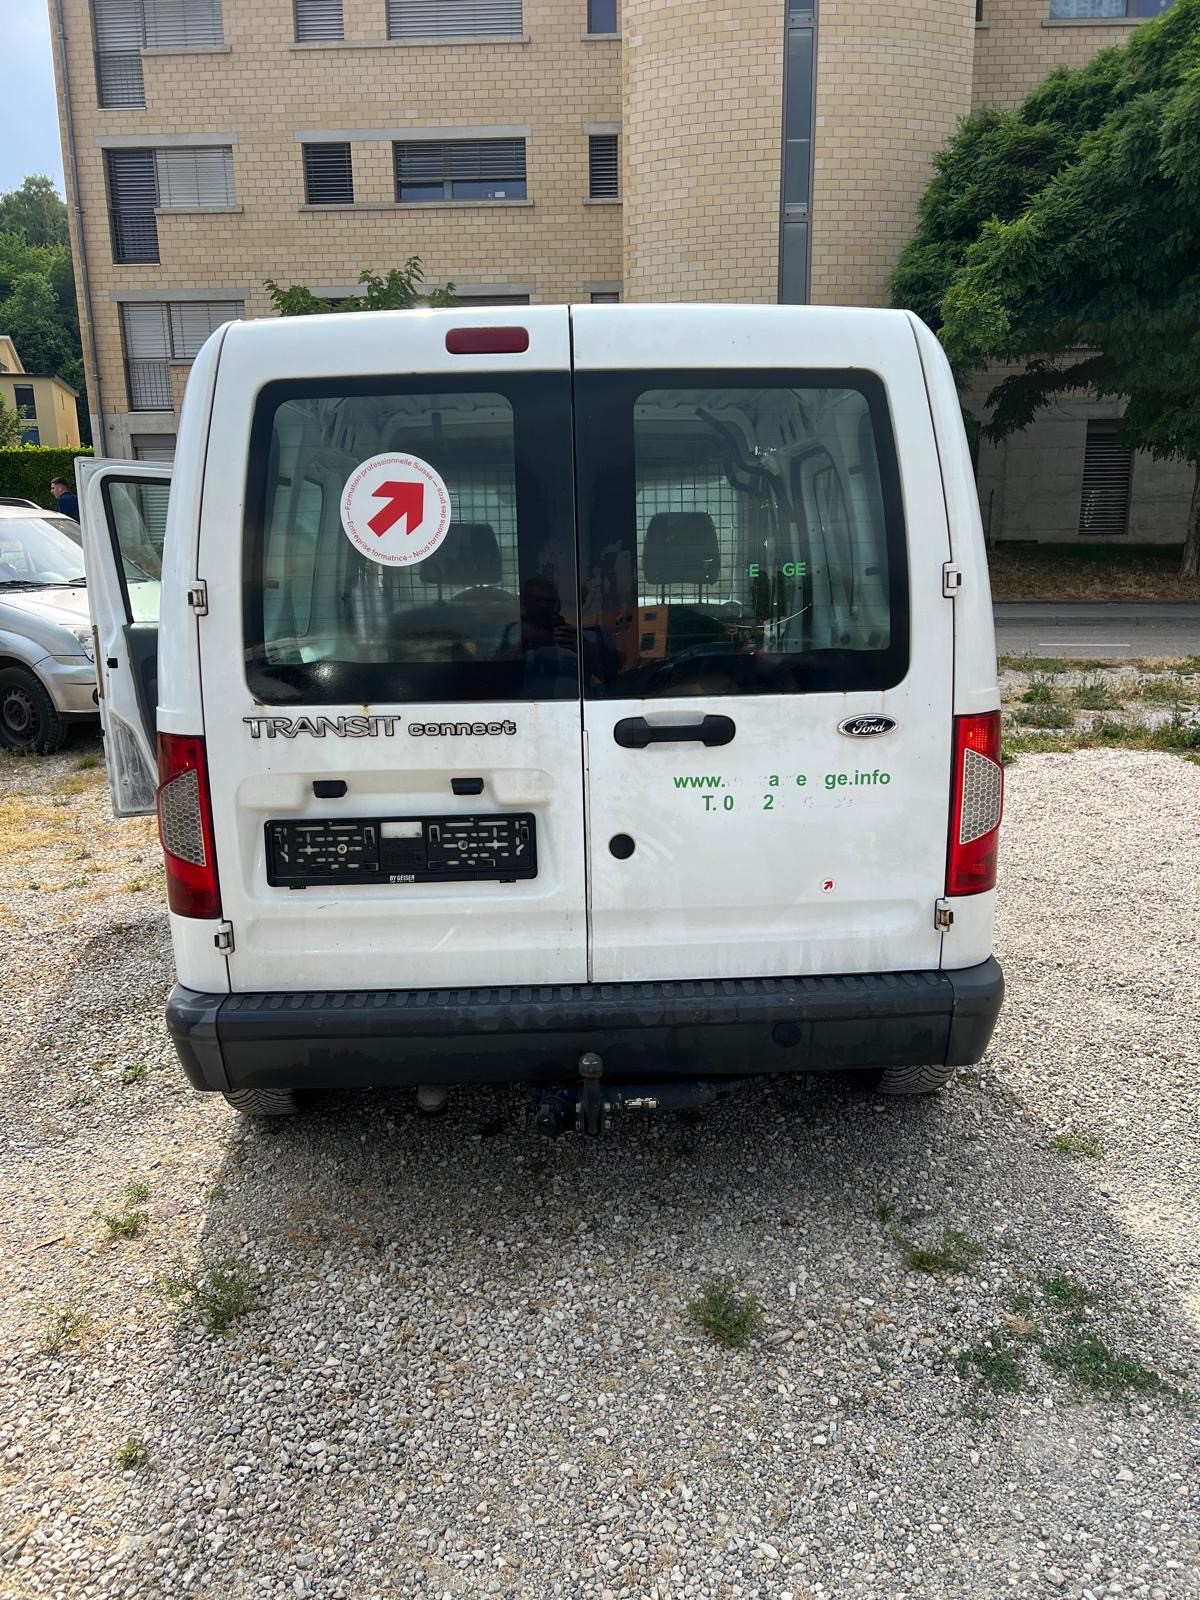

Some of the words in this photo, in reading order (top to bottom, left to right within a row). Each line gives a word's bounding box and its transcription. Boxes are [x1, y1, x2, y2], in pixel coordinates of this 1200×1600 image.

[345, 475, 362, 511] Formation
[361, 458, 412, 477] professionnelle
[413, 462, 433, 480] Suisse
[347, 521, 372, 552] Entreprise
[371, 549, 407, 561] formatrice
[413, 544, 430, 558] Nous
[428, 519, 446, 546] formons
[437, 487, 447, 504] pros
[749, 563, 759, 577] E
[783, 562, 806, 577] GE
[242, 715, 401, 739] TRANSIT
[408, 720, 517, 737] connect
